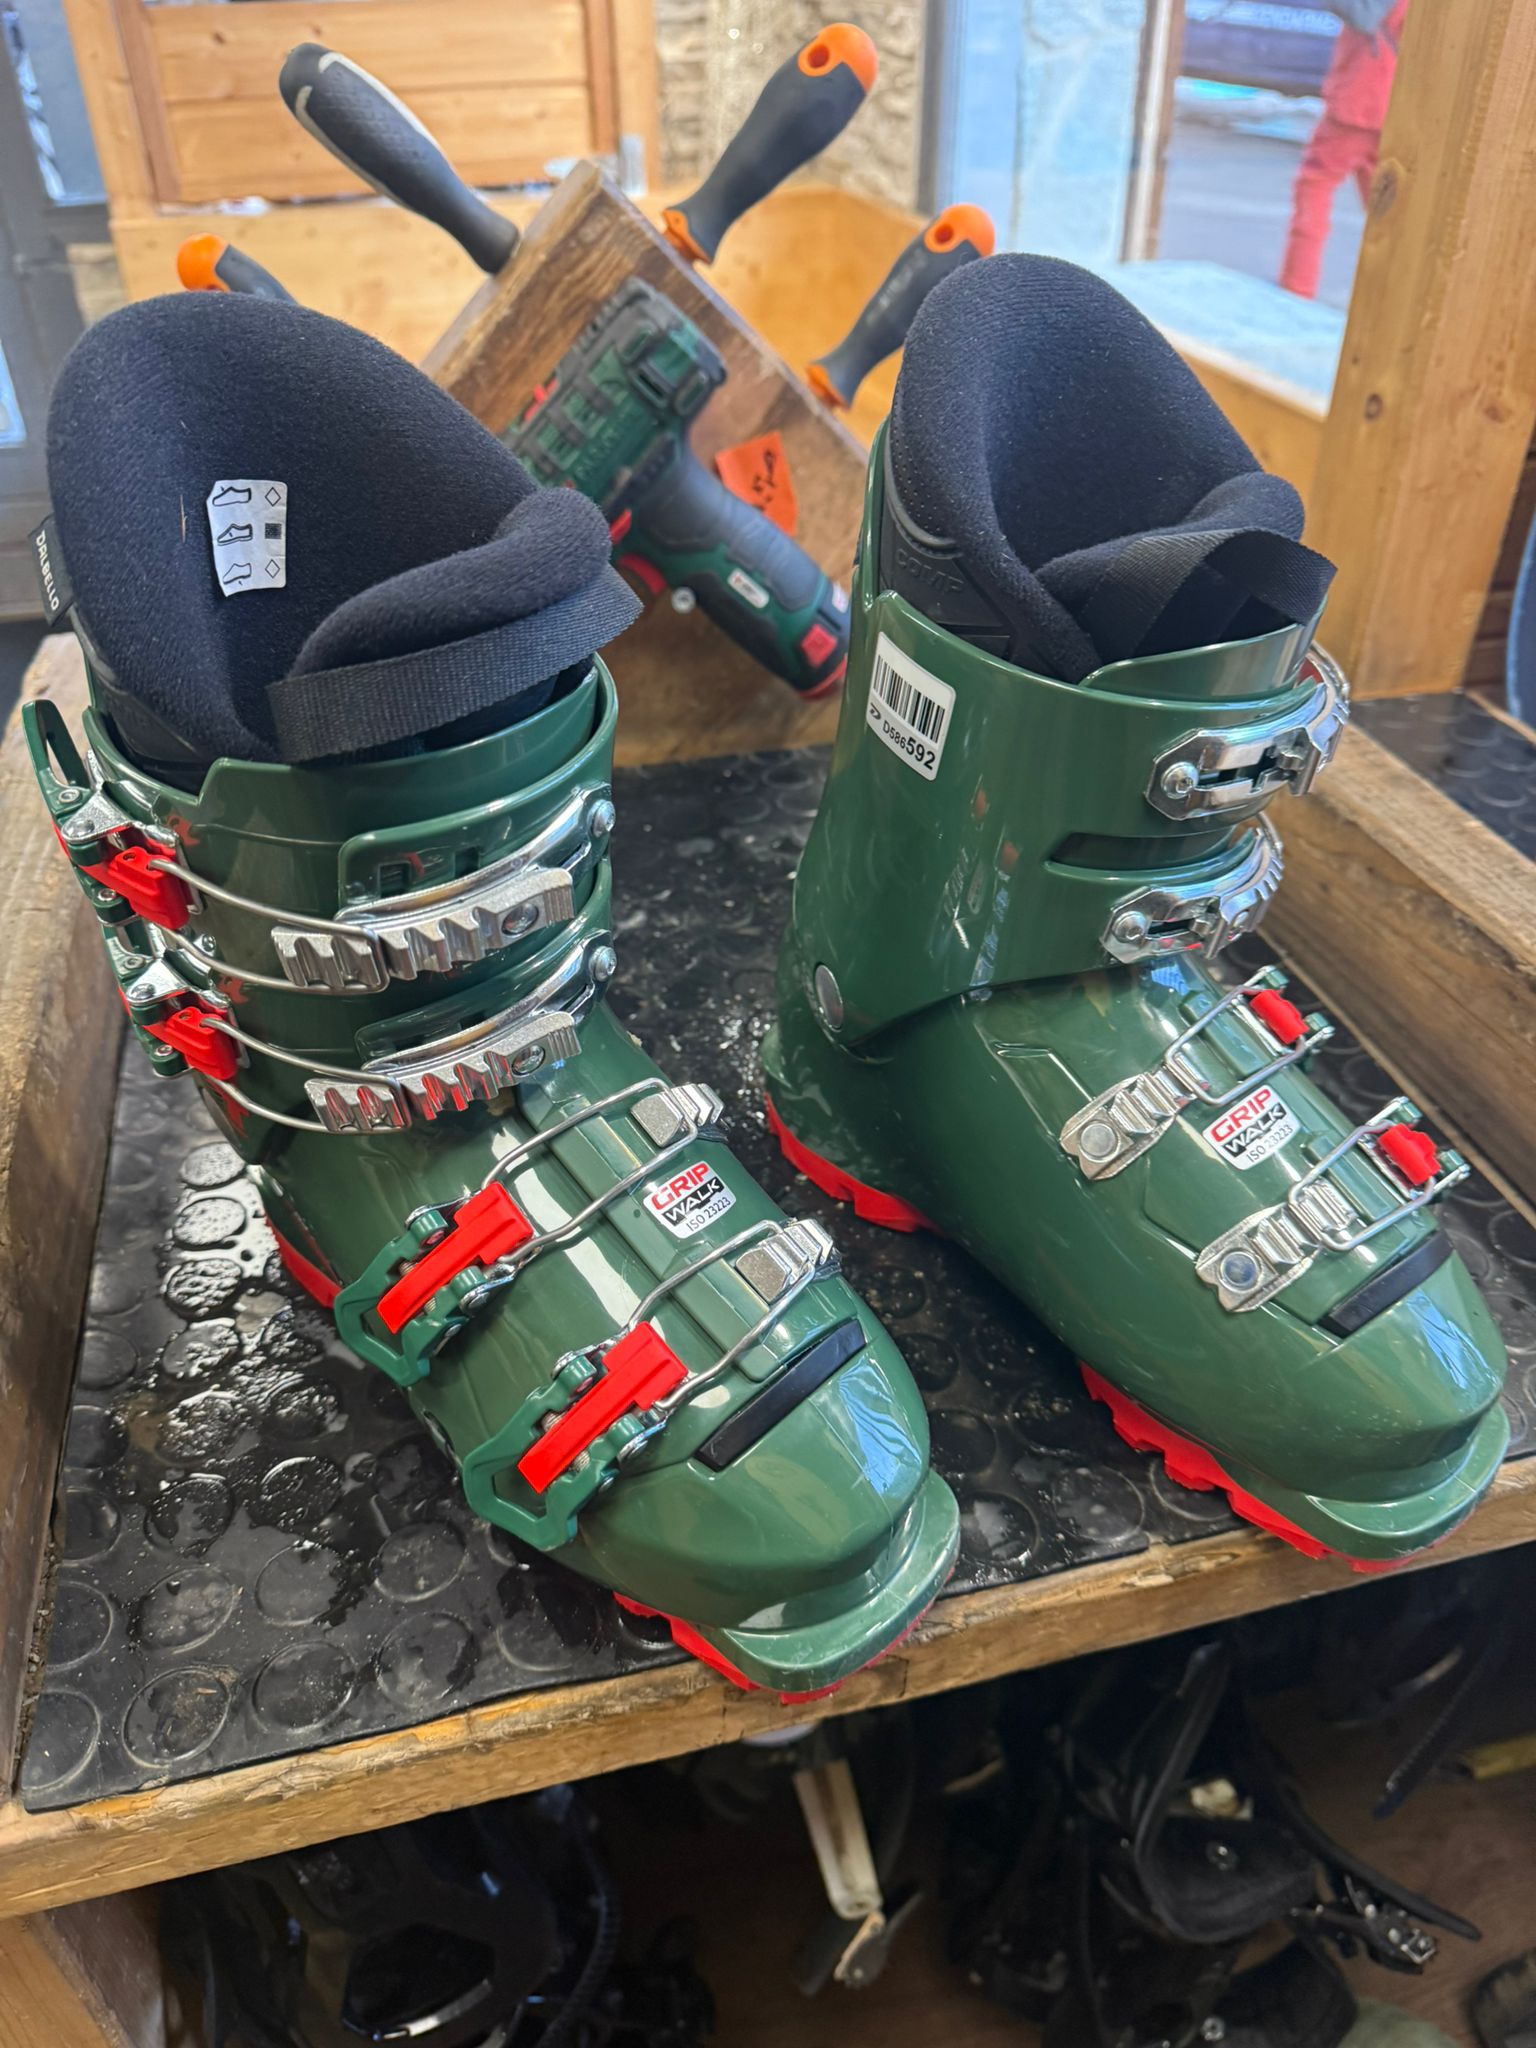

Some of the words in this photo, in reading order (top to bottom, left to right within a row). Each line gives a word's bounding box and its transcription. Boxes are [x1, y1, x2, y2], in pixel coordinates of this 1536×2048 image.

[36, 529, 60, 611] DALBELLO
[882, 720, 936, 771] D586592
[1210, 1088, 1272, 1143] GRIP
[1224, 1104, 1285, 1153] WALK
[1246, 1145, 1266, 1163] ISO
[1264, 1124, 1294, 1148] 23223
[651, 1162, 710, 1210] GRIP
[665, 1178, 720, 1222] WALK
[686, 1214, 706, 1232] ISO
[704, 1196, 731, 1219] 23223
